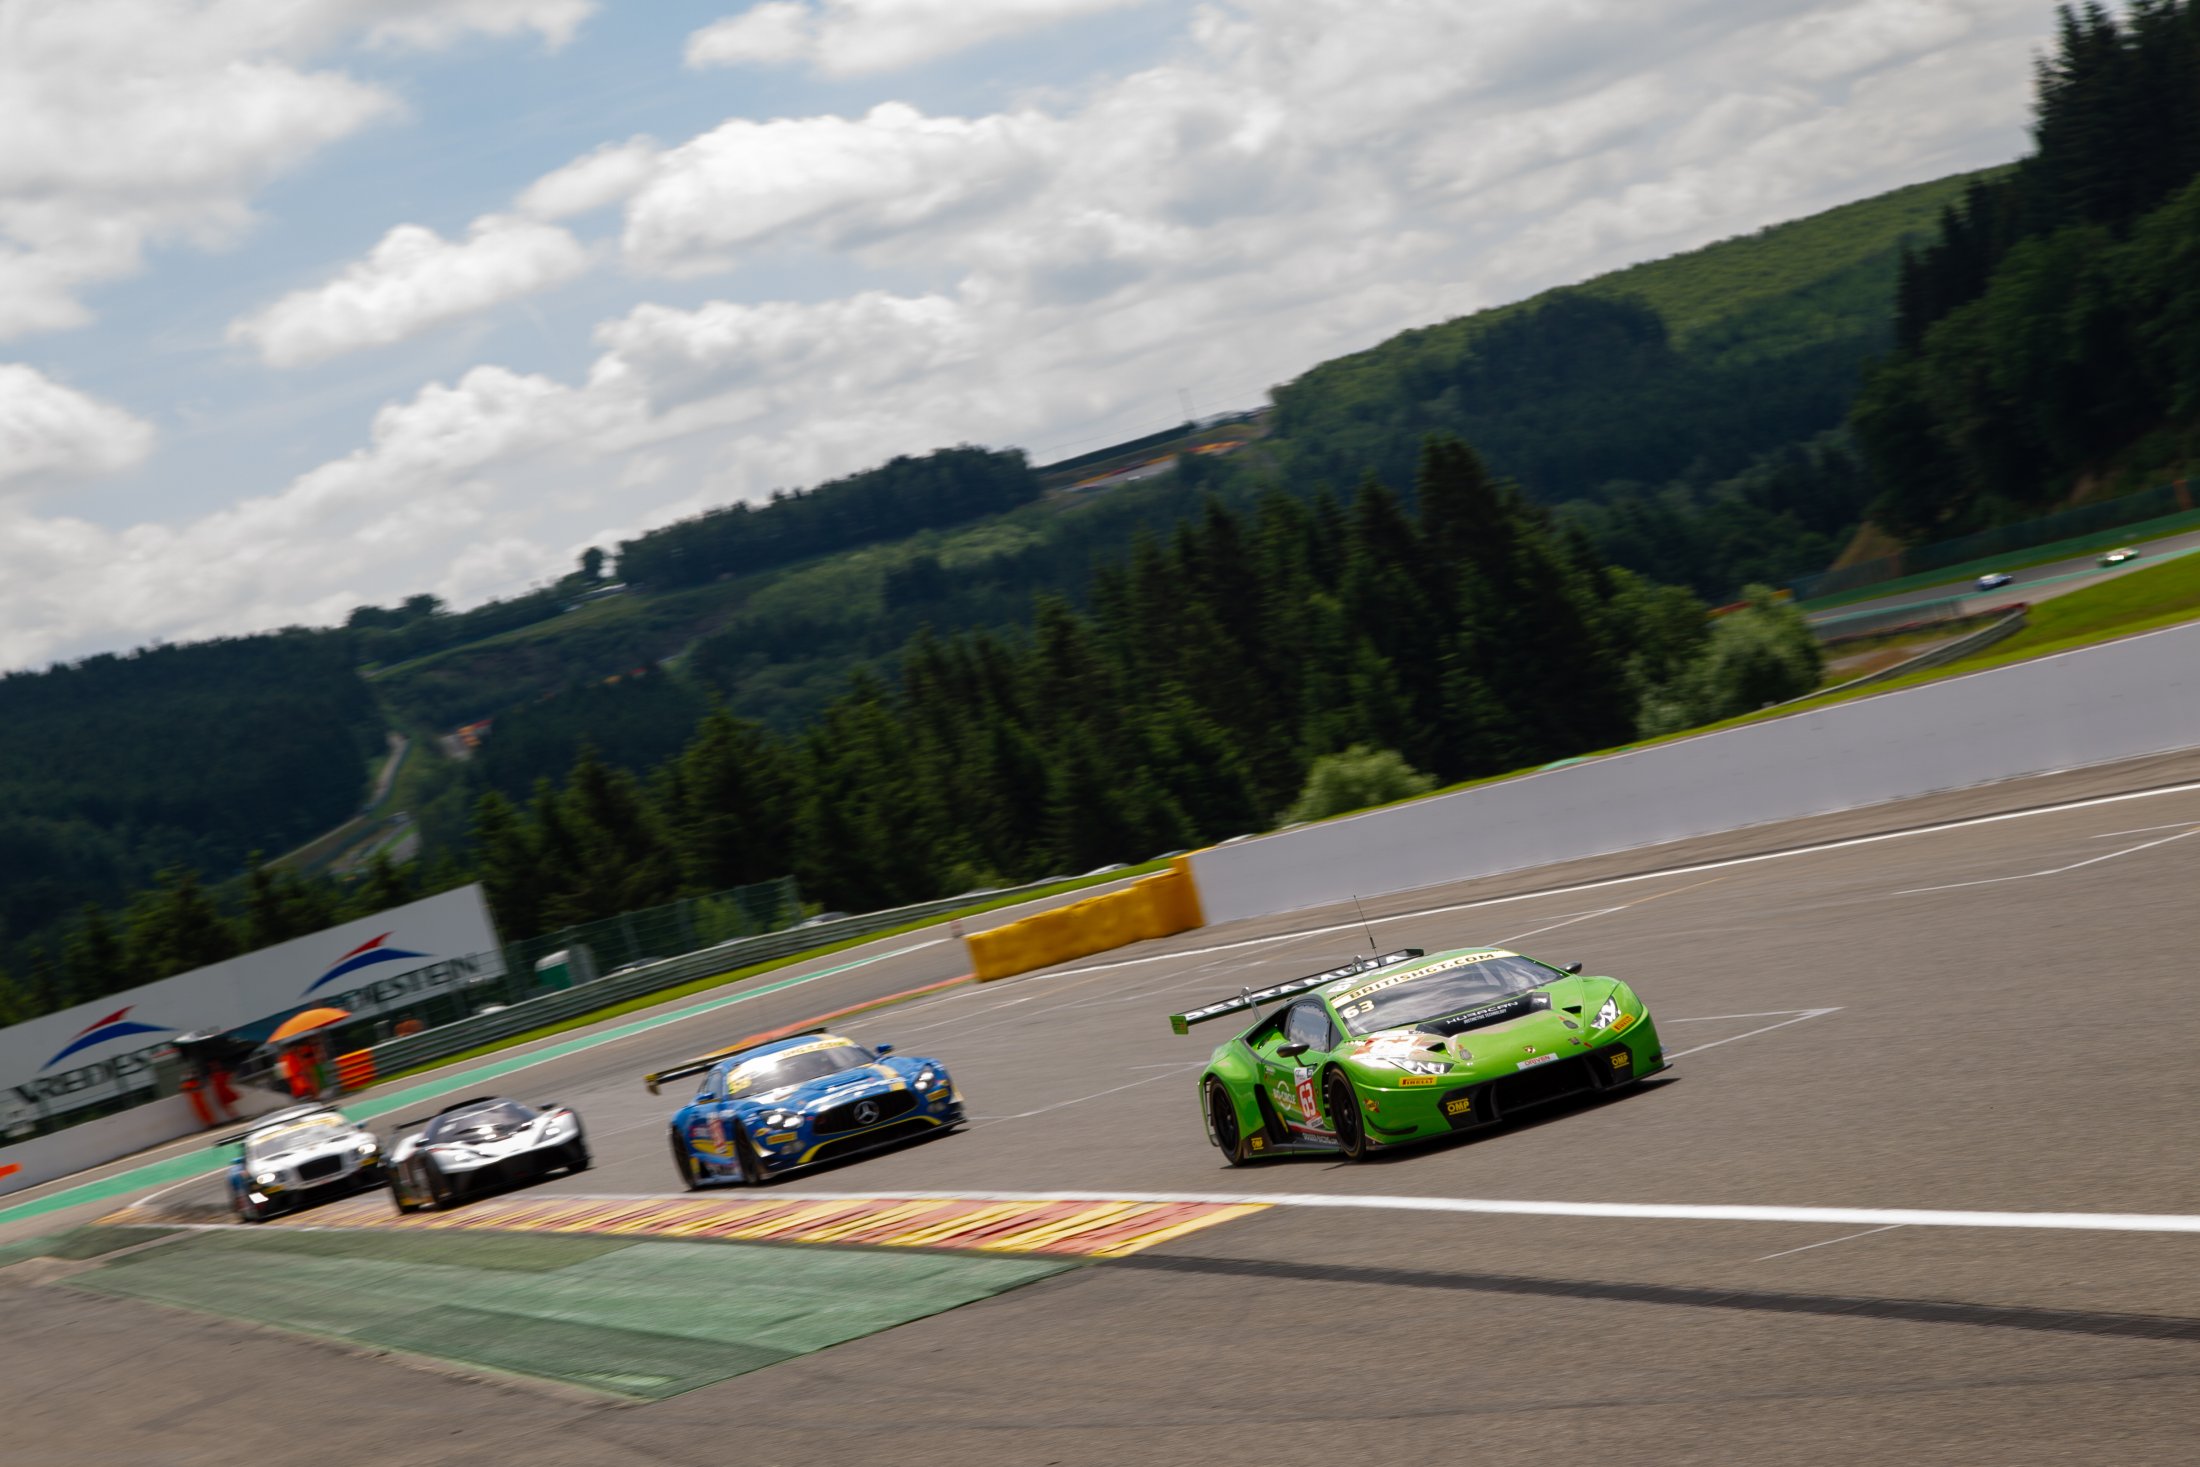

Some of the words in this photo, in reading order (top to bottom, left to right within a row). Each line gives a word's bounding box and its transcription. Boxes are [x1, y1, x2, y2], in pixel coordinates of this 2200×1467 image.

[1349, 953, 1495, 999] BRITISHGT.COM
[1342, 999, 1375, 1019] 63
[1611, 1055, 1629, 1066] OMP
[1299, 1083, 1316, 1118] 63
[1447, 1101, 1470, 1112] OMP
